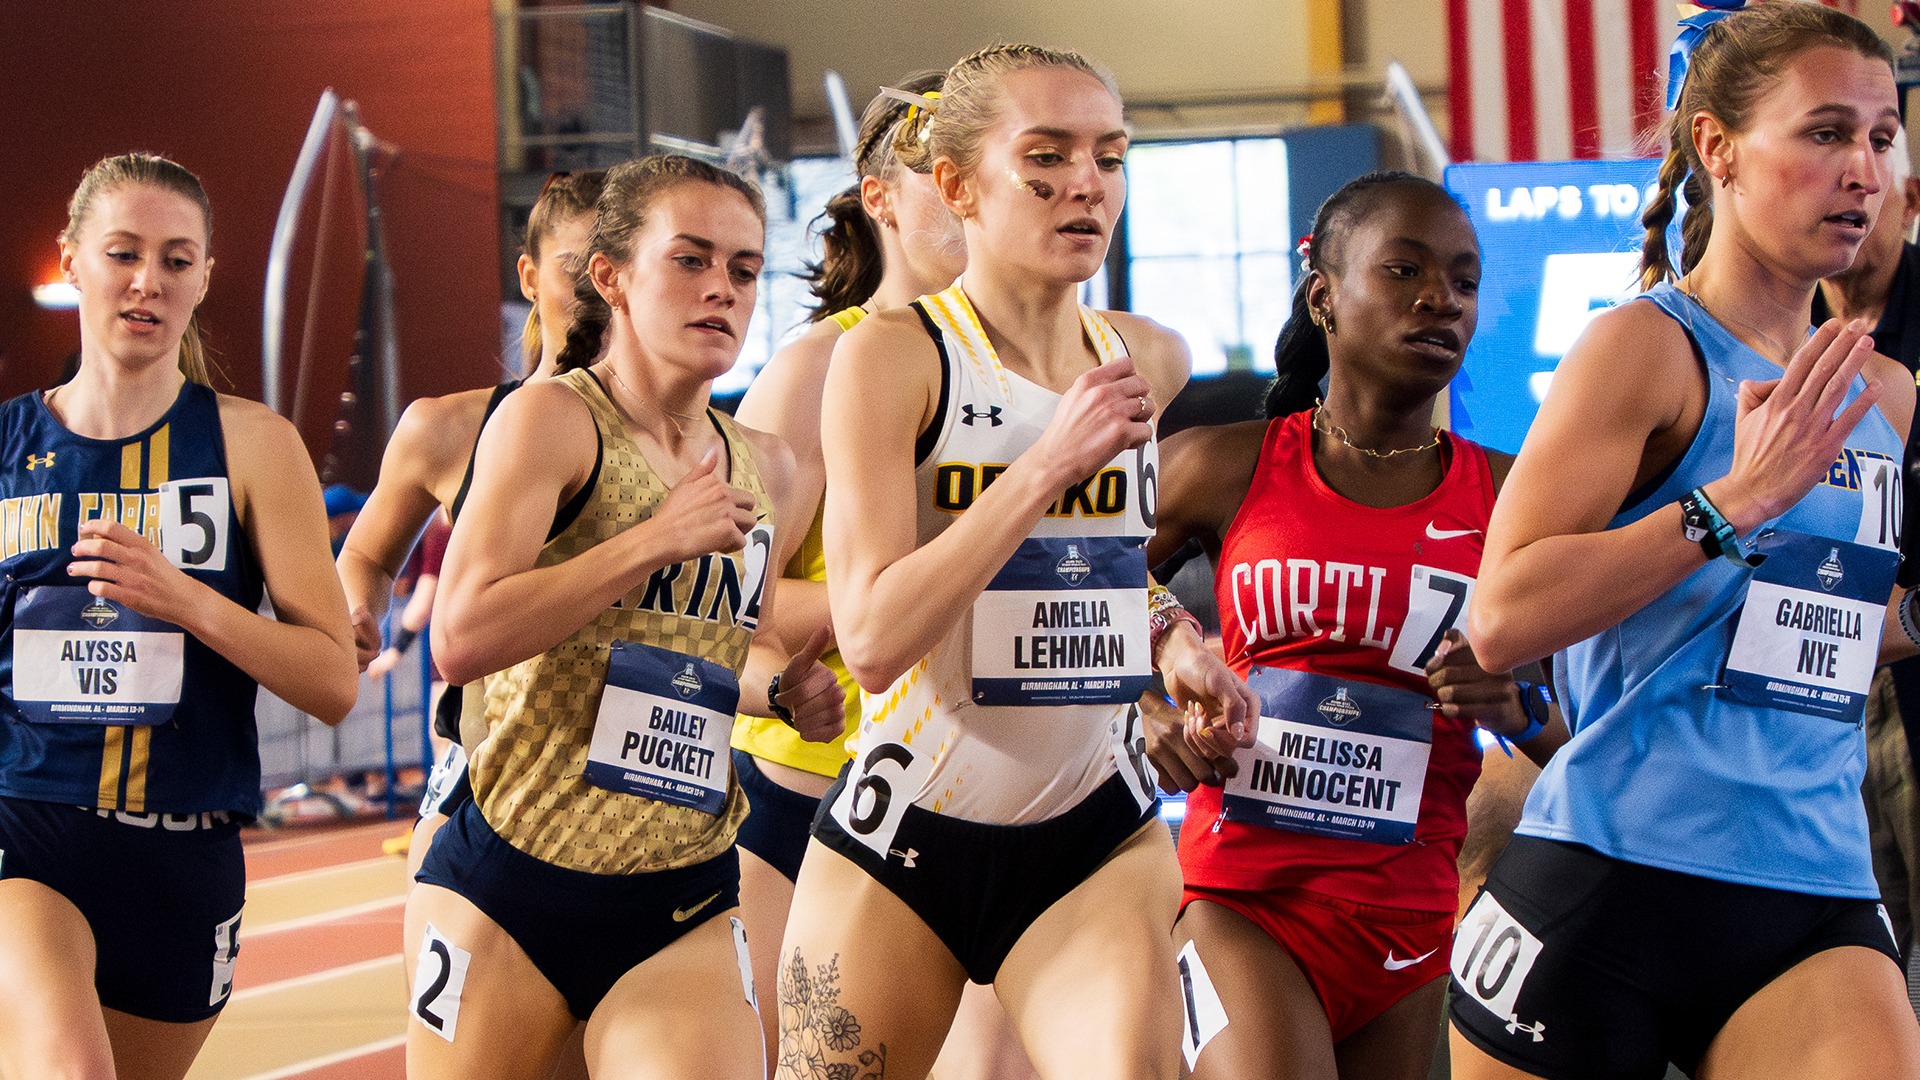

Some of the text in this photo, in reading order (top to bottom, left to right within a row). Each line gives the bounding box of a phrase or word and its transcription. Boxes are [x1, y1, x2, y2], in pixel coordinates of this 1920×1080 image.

[1486, 186, 1582, 220] LAPS
[1589, 184, 1639, 215] TO
[1136, 440, 1157, 529] 6
[178, 484, 216, 565] 5
[1873, 464, 1900, 549] 10
[744, 529, 770, 619] 2
[1032, 600, 1111, 629] AMELIA
[1231, 559, 1394, 650] CORTL
[1411, 574, 1468, 669] 7
[1775, 598, 1861, 641] GABRIELLA
[61, 640, 137, 662] ALYSSA
[1014, 634, 1125, 669] LEHMAN
[1797, 638, 1839, 679] NYE
[78, 668, 117, 695] VIS
[1020, 680, 1121, 691] BIRMINGHAM, AL MARCH 13-14
[649, 705, 707, 741] BAILEY
[620, 730, 715, 780] PUCKETT
[1279, 731, 1382, 771] MELISSA
[623, 772, 663, 789] BIRMINGHAM,
[664, 781, 673, 790] AL
[675, 784, 694, 795] MARCH
[848, 742, 914, 835] 6
[1250, 759, 1401, 813] INNOCENT
[1266, 805, 1315, 822] BIRMINGHAM,
[1316, 813, 1326, 822] AL
[1331, 815, 1357, 828] MARCH
[1461, 910, 1522, 1001] 10
[417, 938, 451, 1031] 2
